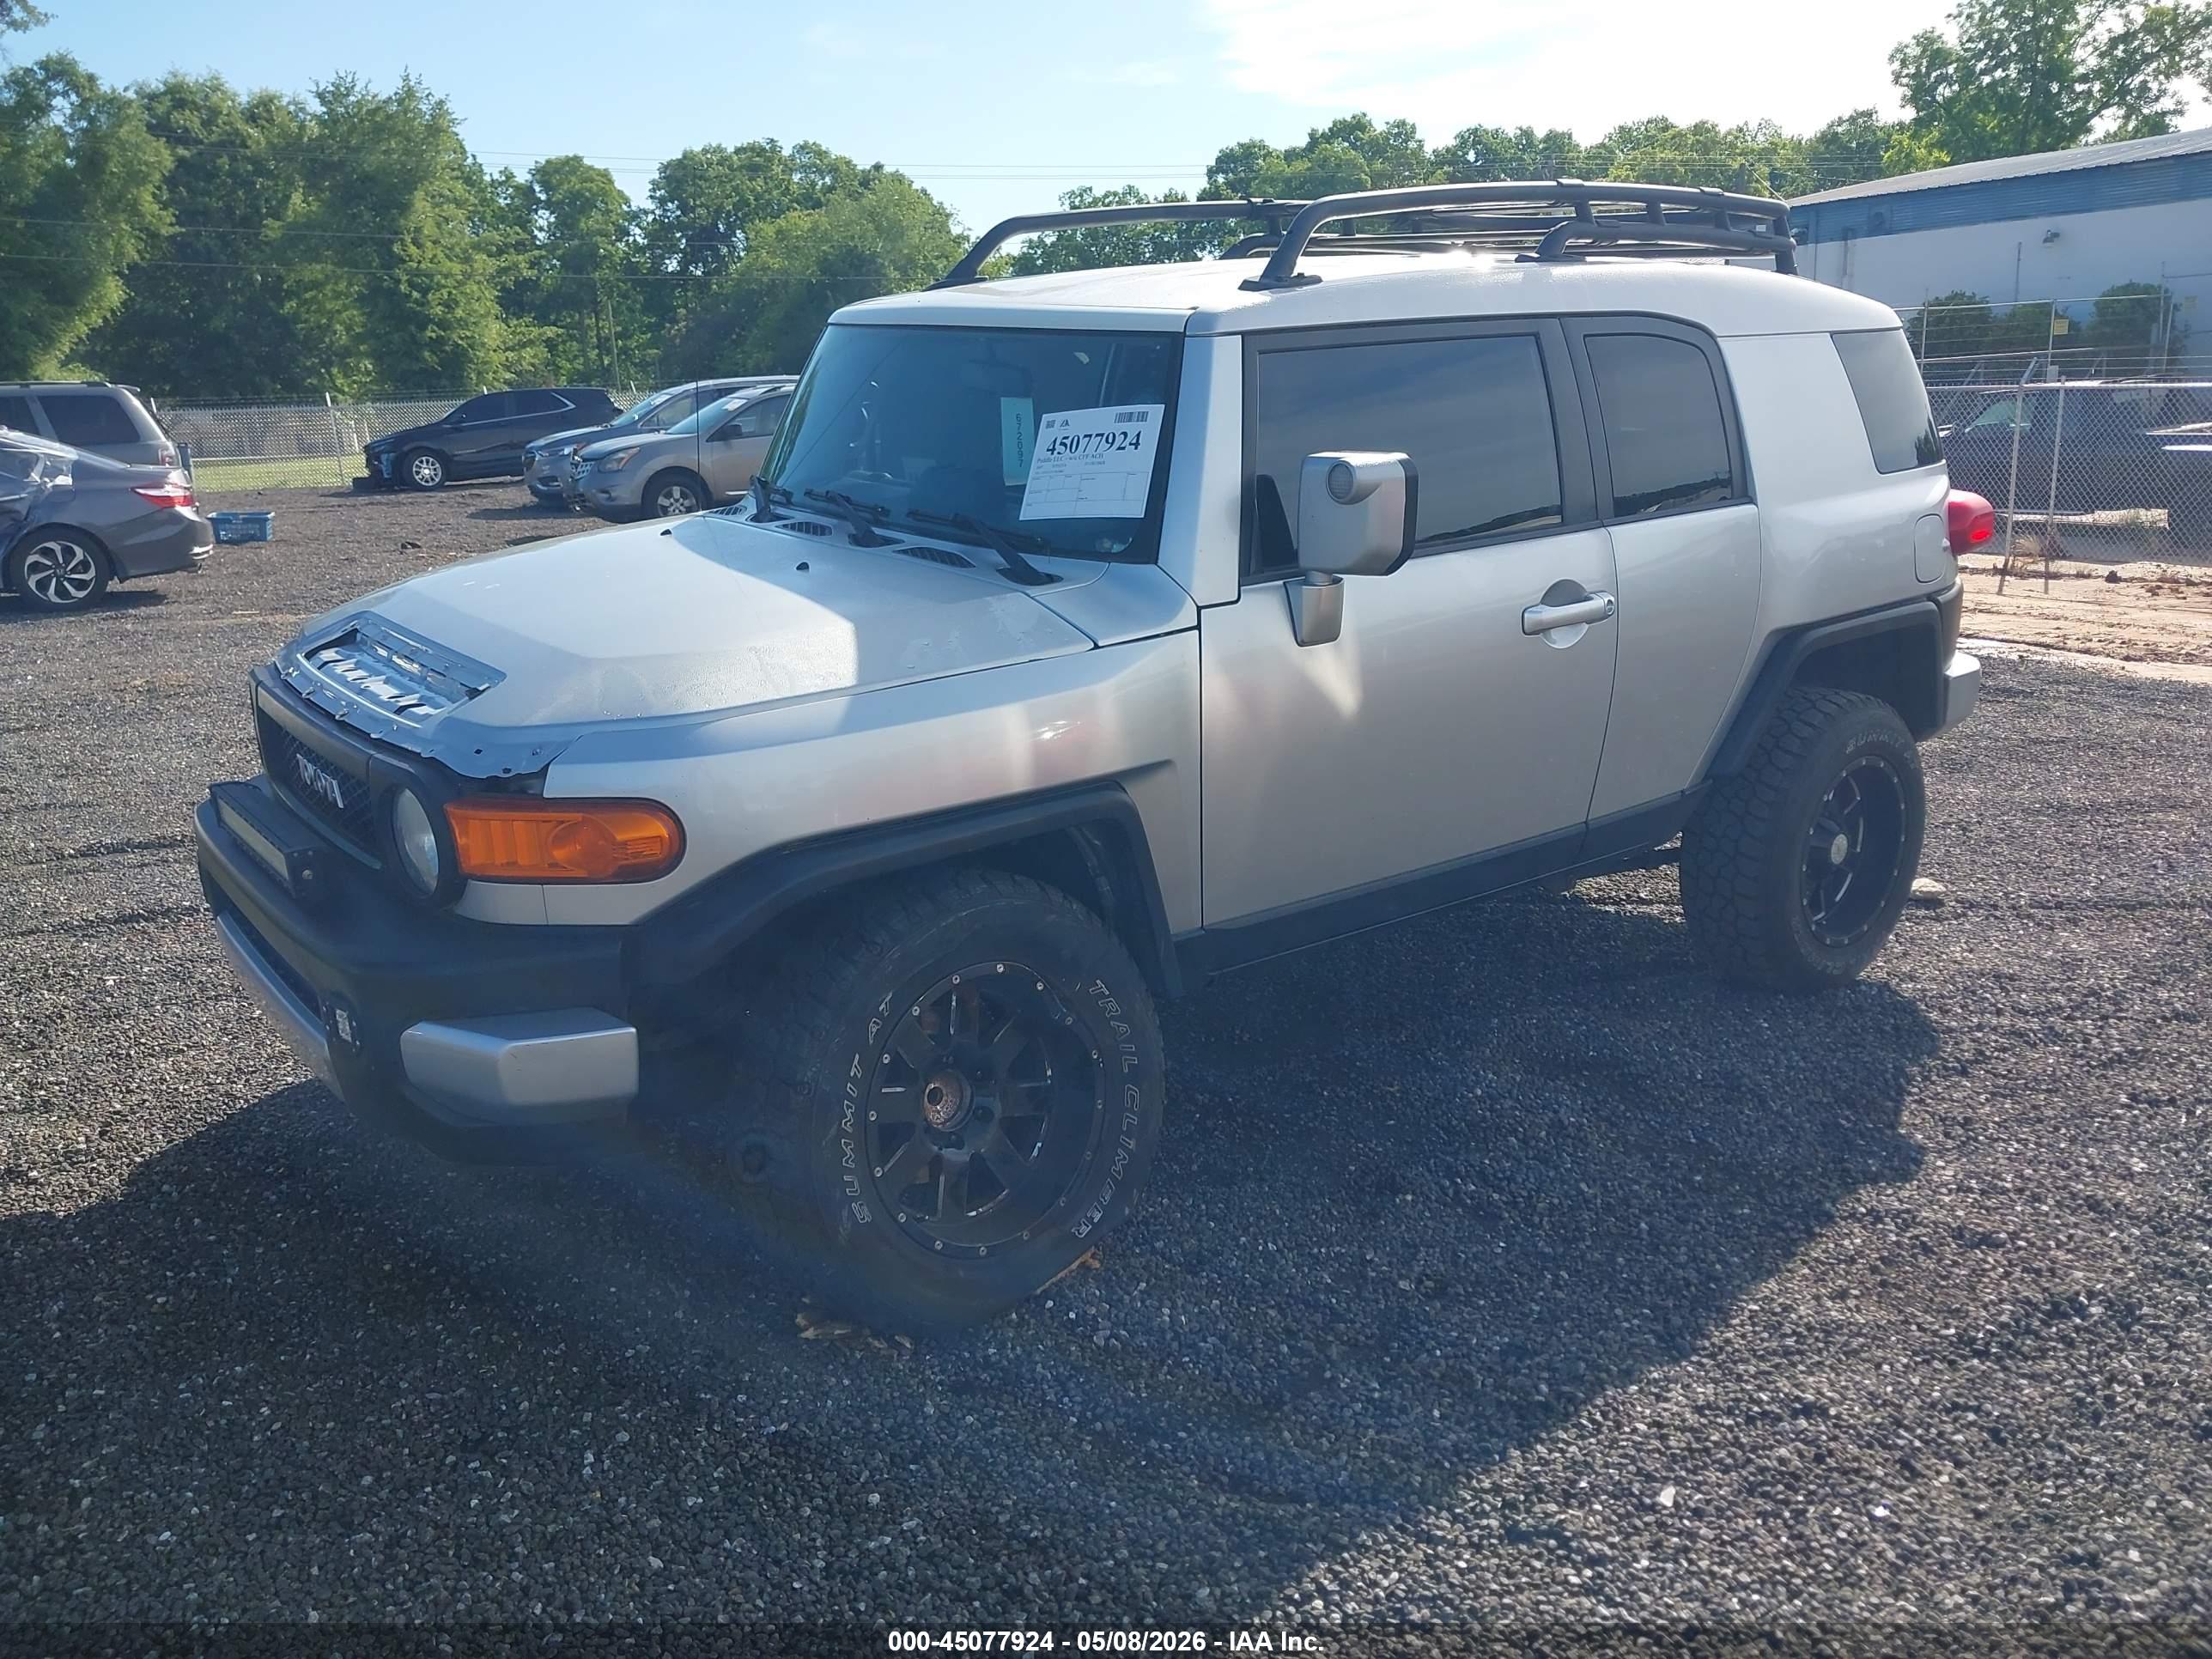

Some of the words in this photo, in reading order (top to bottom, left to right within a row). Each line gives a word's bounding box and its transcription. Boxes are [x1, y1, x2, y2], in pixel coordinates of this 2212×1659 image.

[1016, 412, 1024, 468] 672097
[1046, 430, 1142, 457] 45077924
[295, 753, 344, 809] TOYOTA
[1089, 979, 1139, 1073] TRAIL
[841, 1053, 872, 1224] SUMMIT
[867, 991, 893, 1045] AT
[1071, 1084, 1139, 1238] CLIMBER
